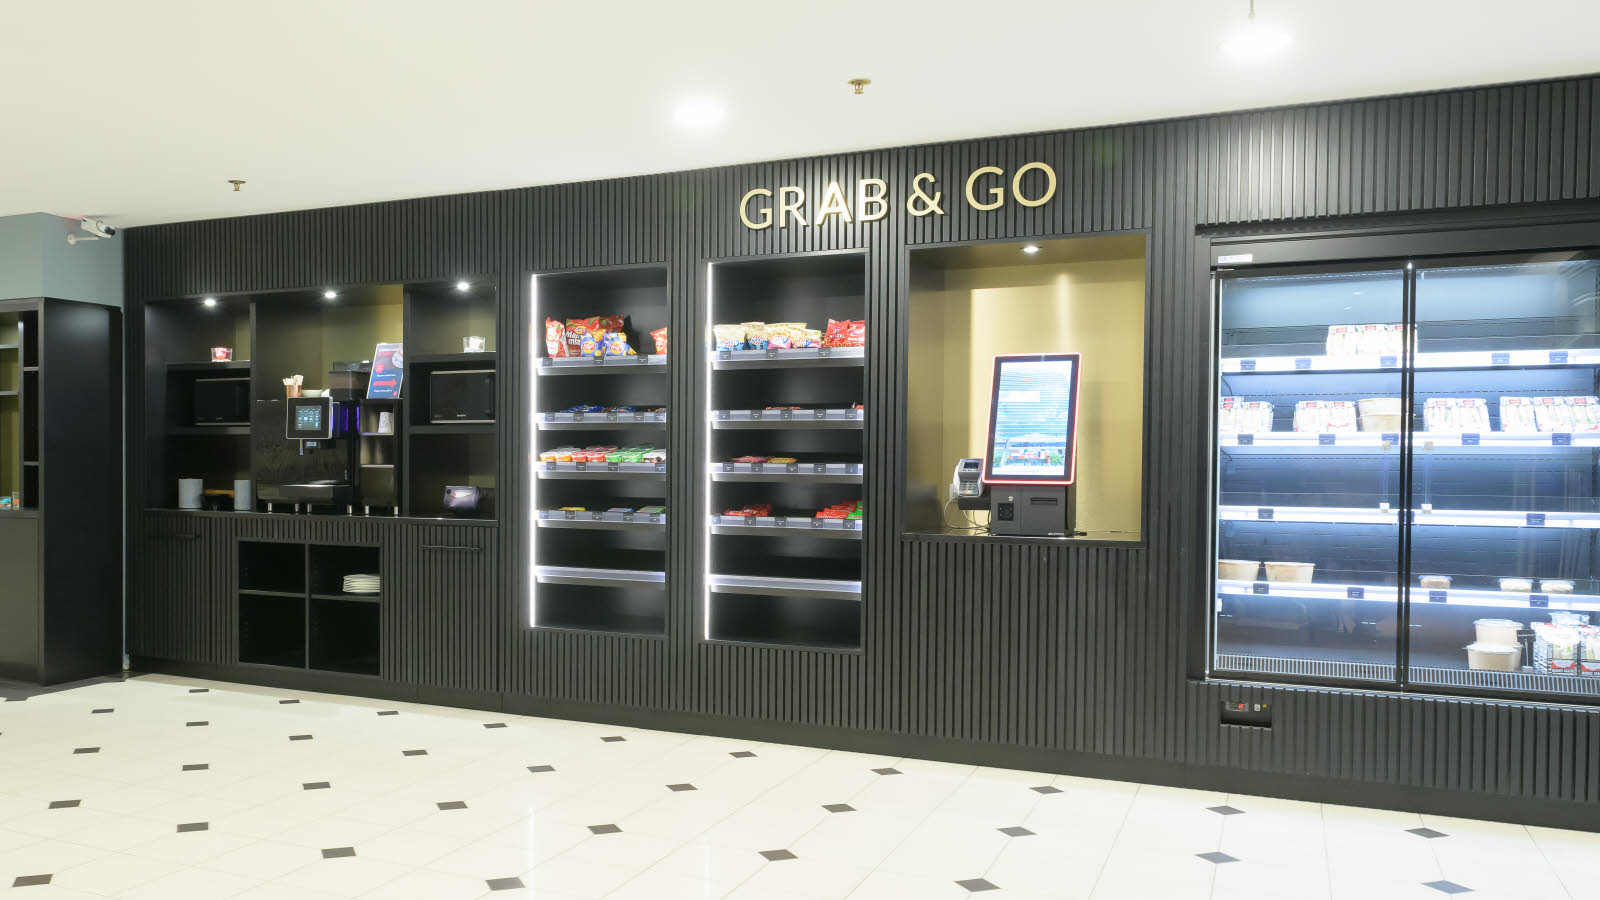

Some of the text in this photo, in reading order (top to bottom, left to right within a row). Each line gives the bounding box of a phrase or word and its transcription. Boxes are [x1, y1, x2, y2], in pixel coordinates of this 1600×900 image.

[740, 162, 1057, 230] GRAB & GO
